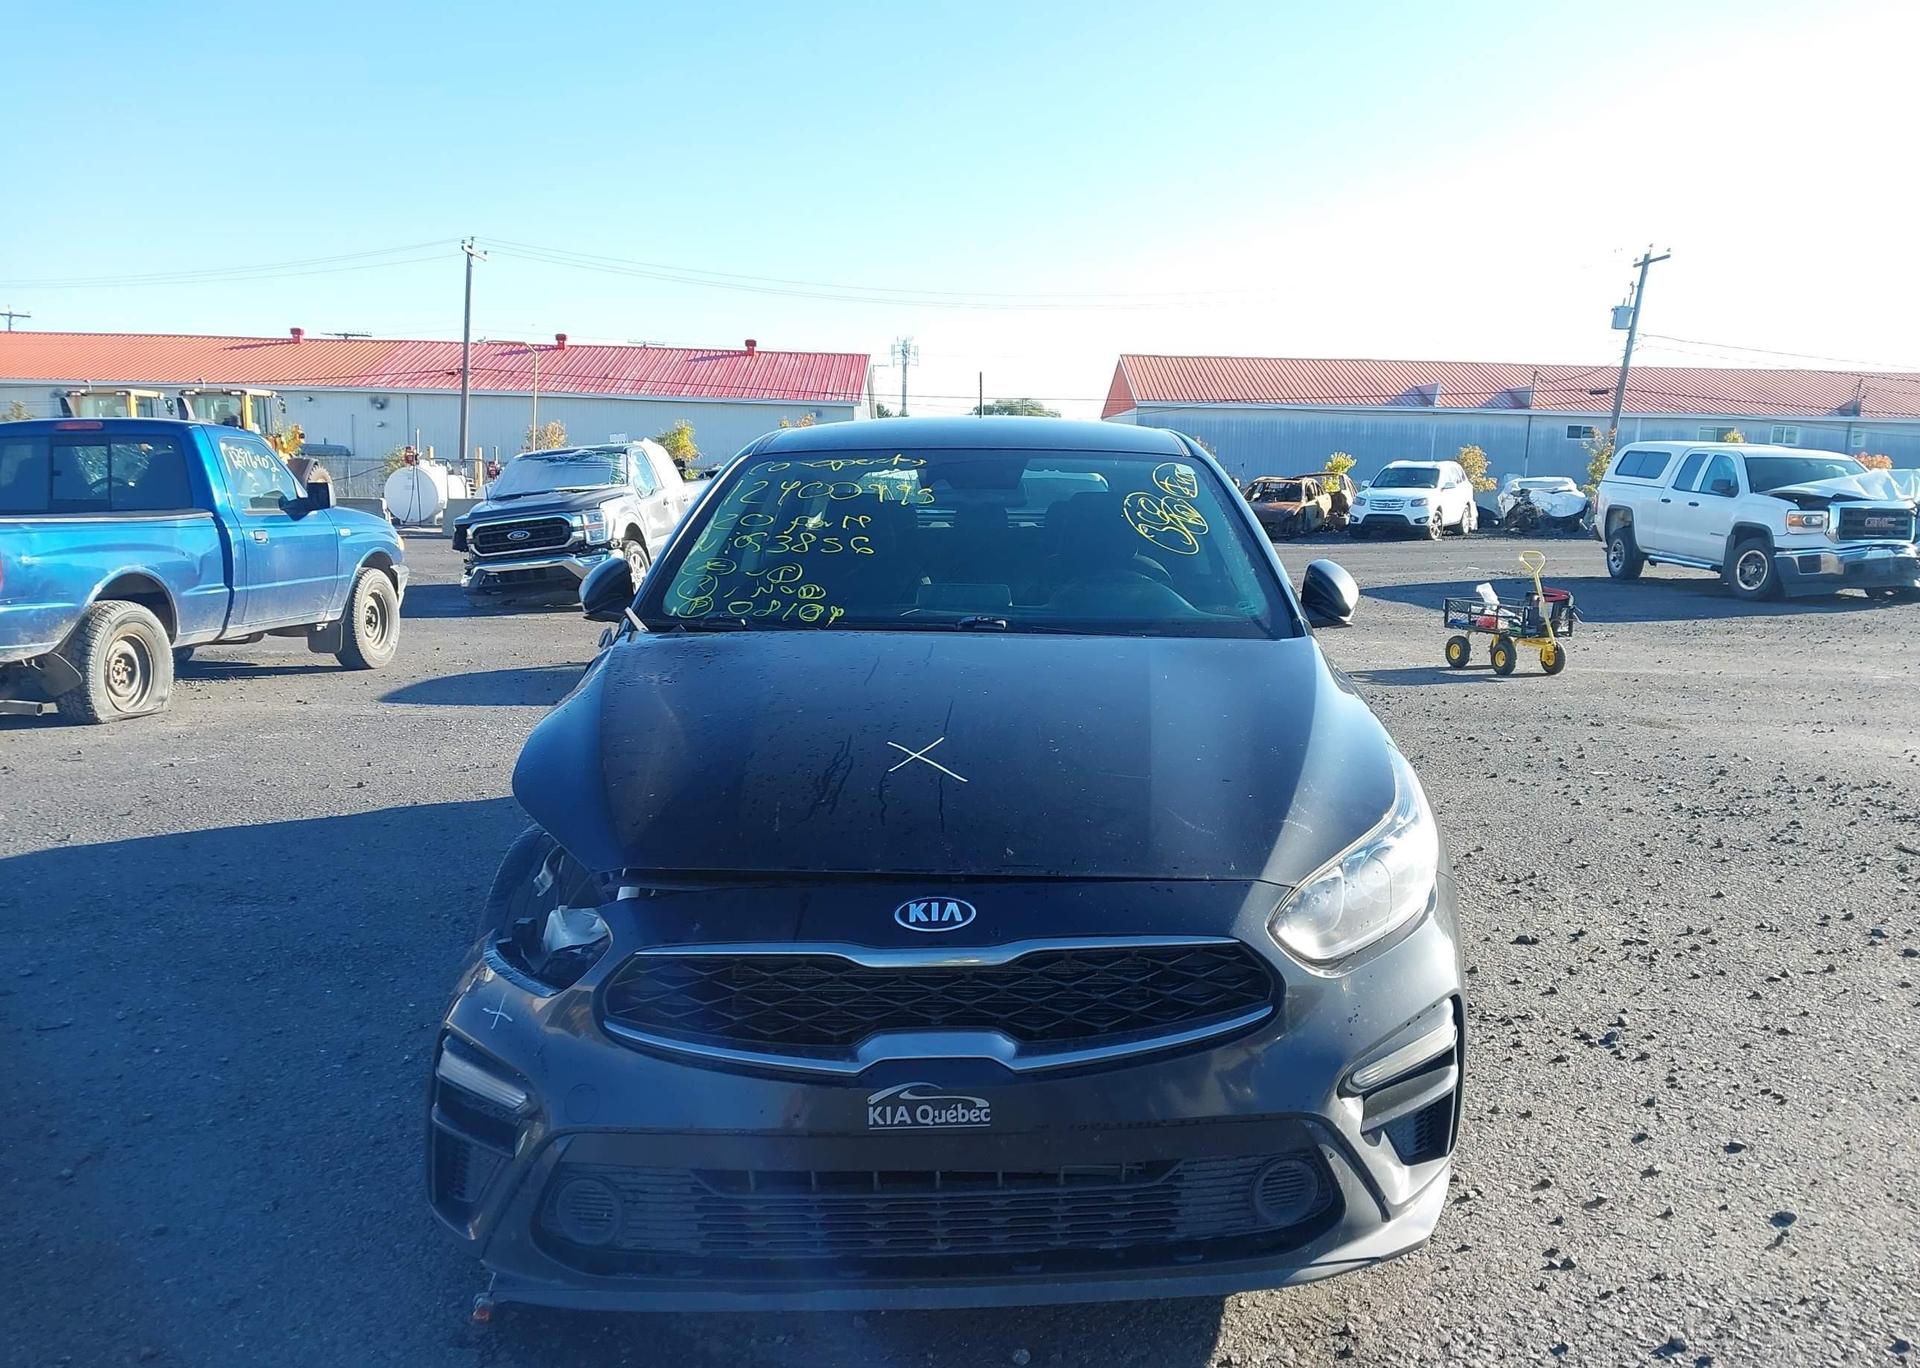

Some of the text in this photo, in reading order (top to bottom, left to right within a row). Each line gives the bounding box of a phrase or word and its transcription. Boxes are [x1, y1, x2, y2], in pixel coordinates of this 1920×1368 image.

[1864, 517, 1897, 528] GMC
[908, 902, 963, 922] KIA
[868, 1104, 991, 1126] KIA Québec
